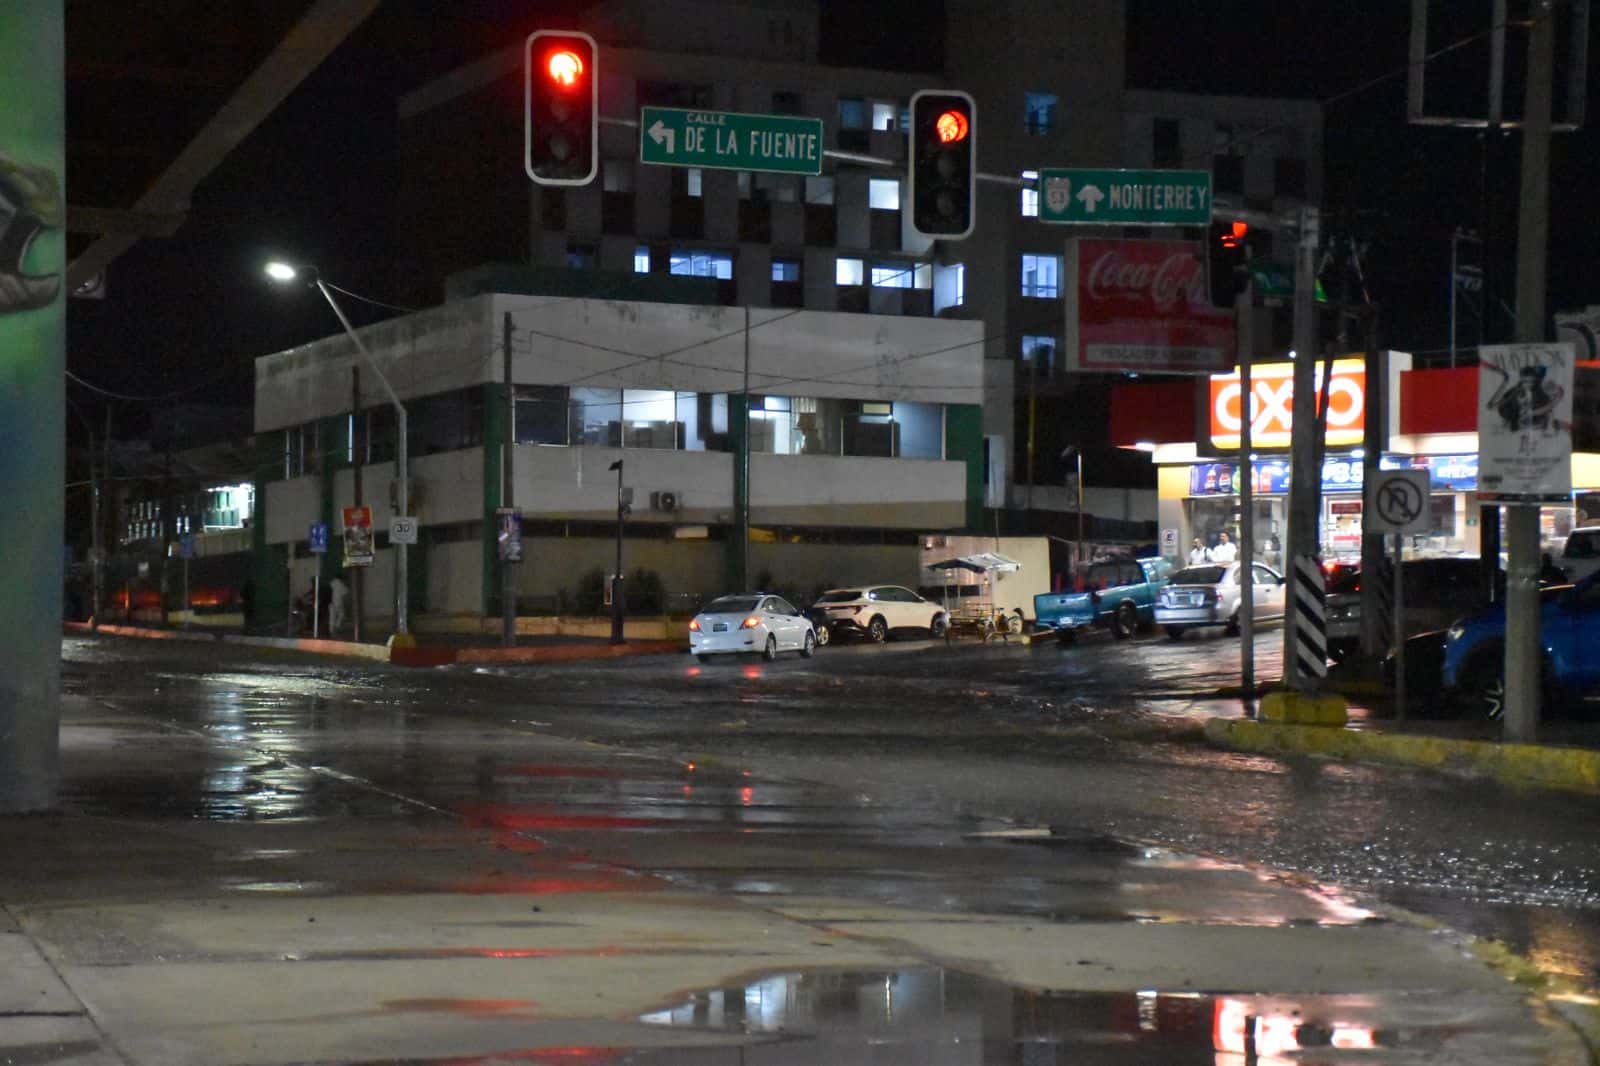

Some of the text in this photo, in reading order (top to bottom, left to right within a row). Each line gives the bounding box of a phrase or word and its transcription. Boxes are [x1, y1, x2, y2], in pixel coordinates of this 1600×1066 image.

[686, 113, 727, 126] CALLE
[685, 126, 817, 160] DE LA FUENTE
[1109, 184, 1208, 211] MONTERREY
[1215, 377, 1365, 432] OXO
